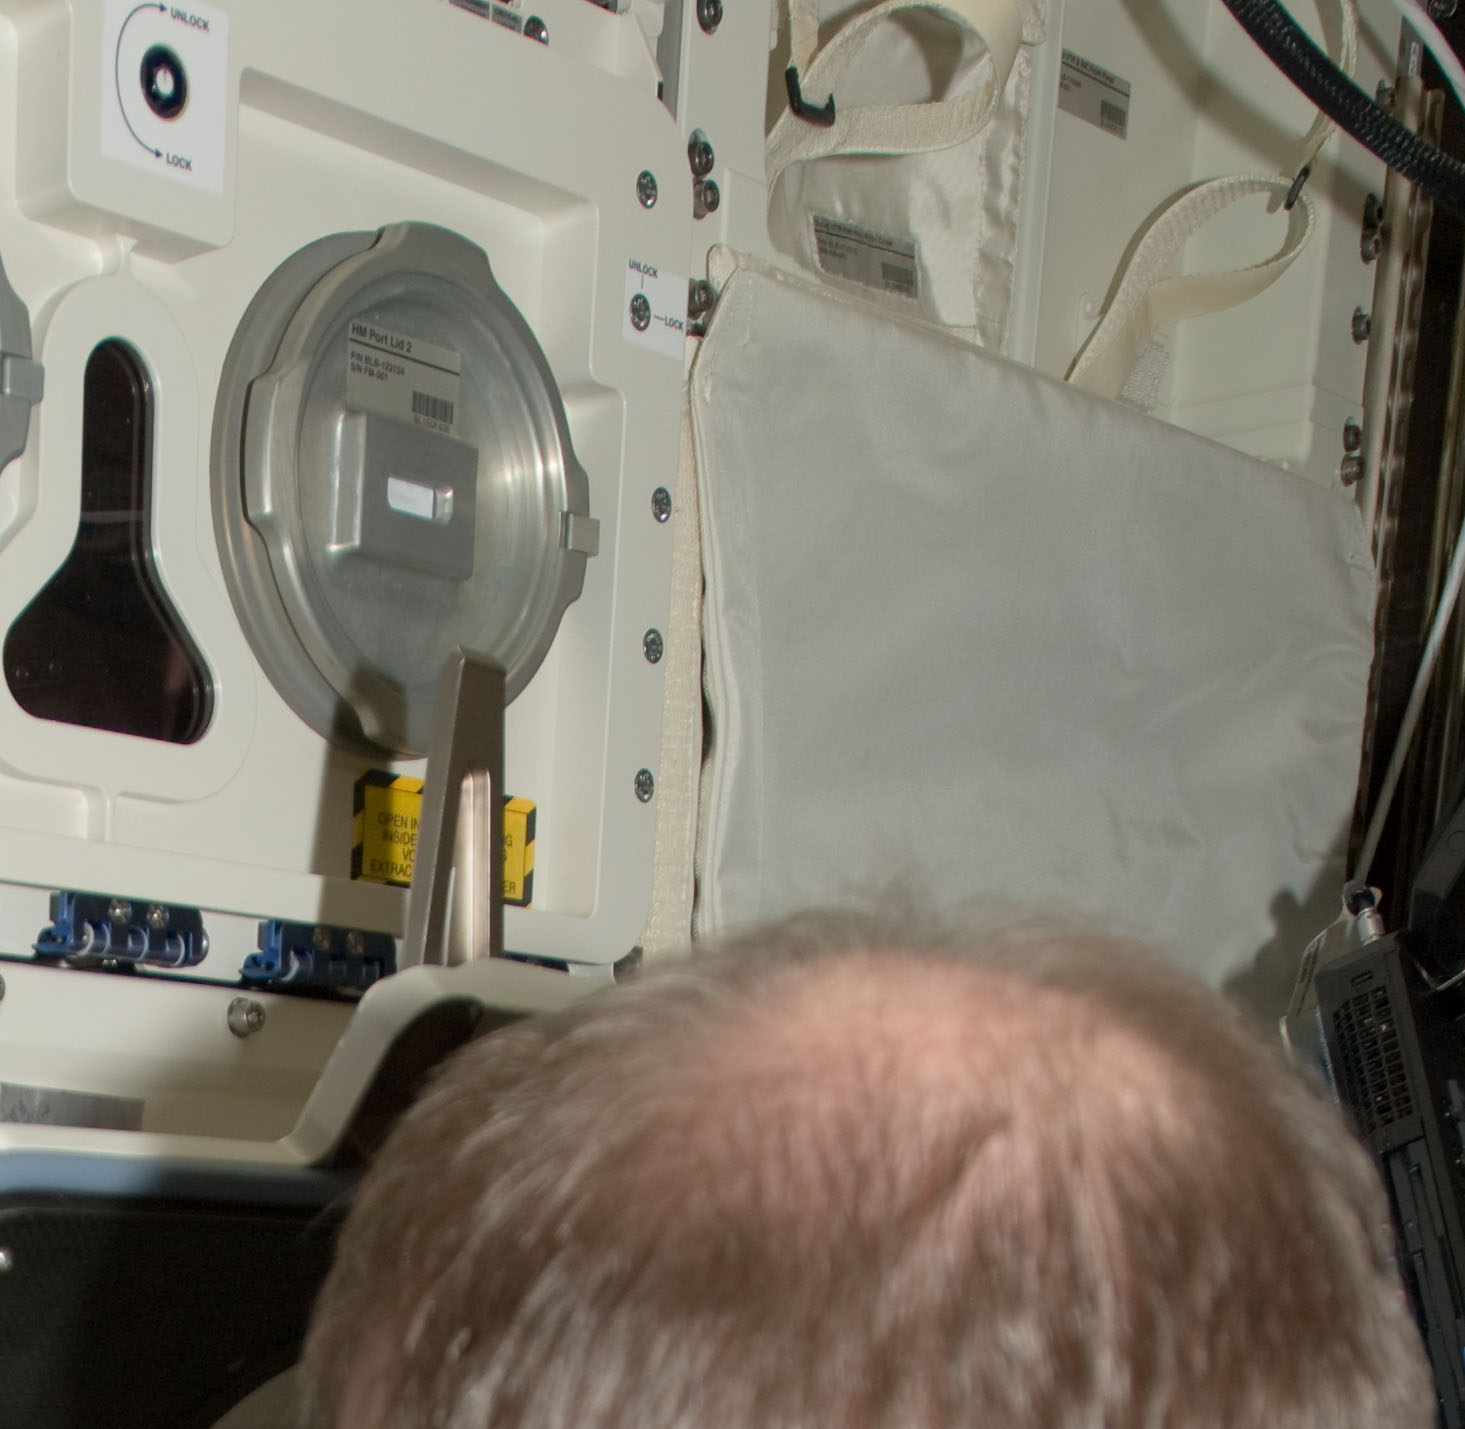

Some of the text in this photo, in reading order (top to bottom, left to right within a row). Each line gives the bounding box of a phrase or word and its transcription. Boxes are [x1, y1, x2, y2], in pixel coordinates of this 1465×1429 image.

[170, 7, 210, 32] UNLOCK
[166, 152, 192, 171] LOCK
[628, 258, 658, 278] UNLOCK
[665, 315, 684, 331] LOCK
[352, 323, 367, 338] HM
[370, 328, 388, 344] Port
[391, 335, 404, 351] Lid
[378, 812, 408, 828] OPEN
